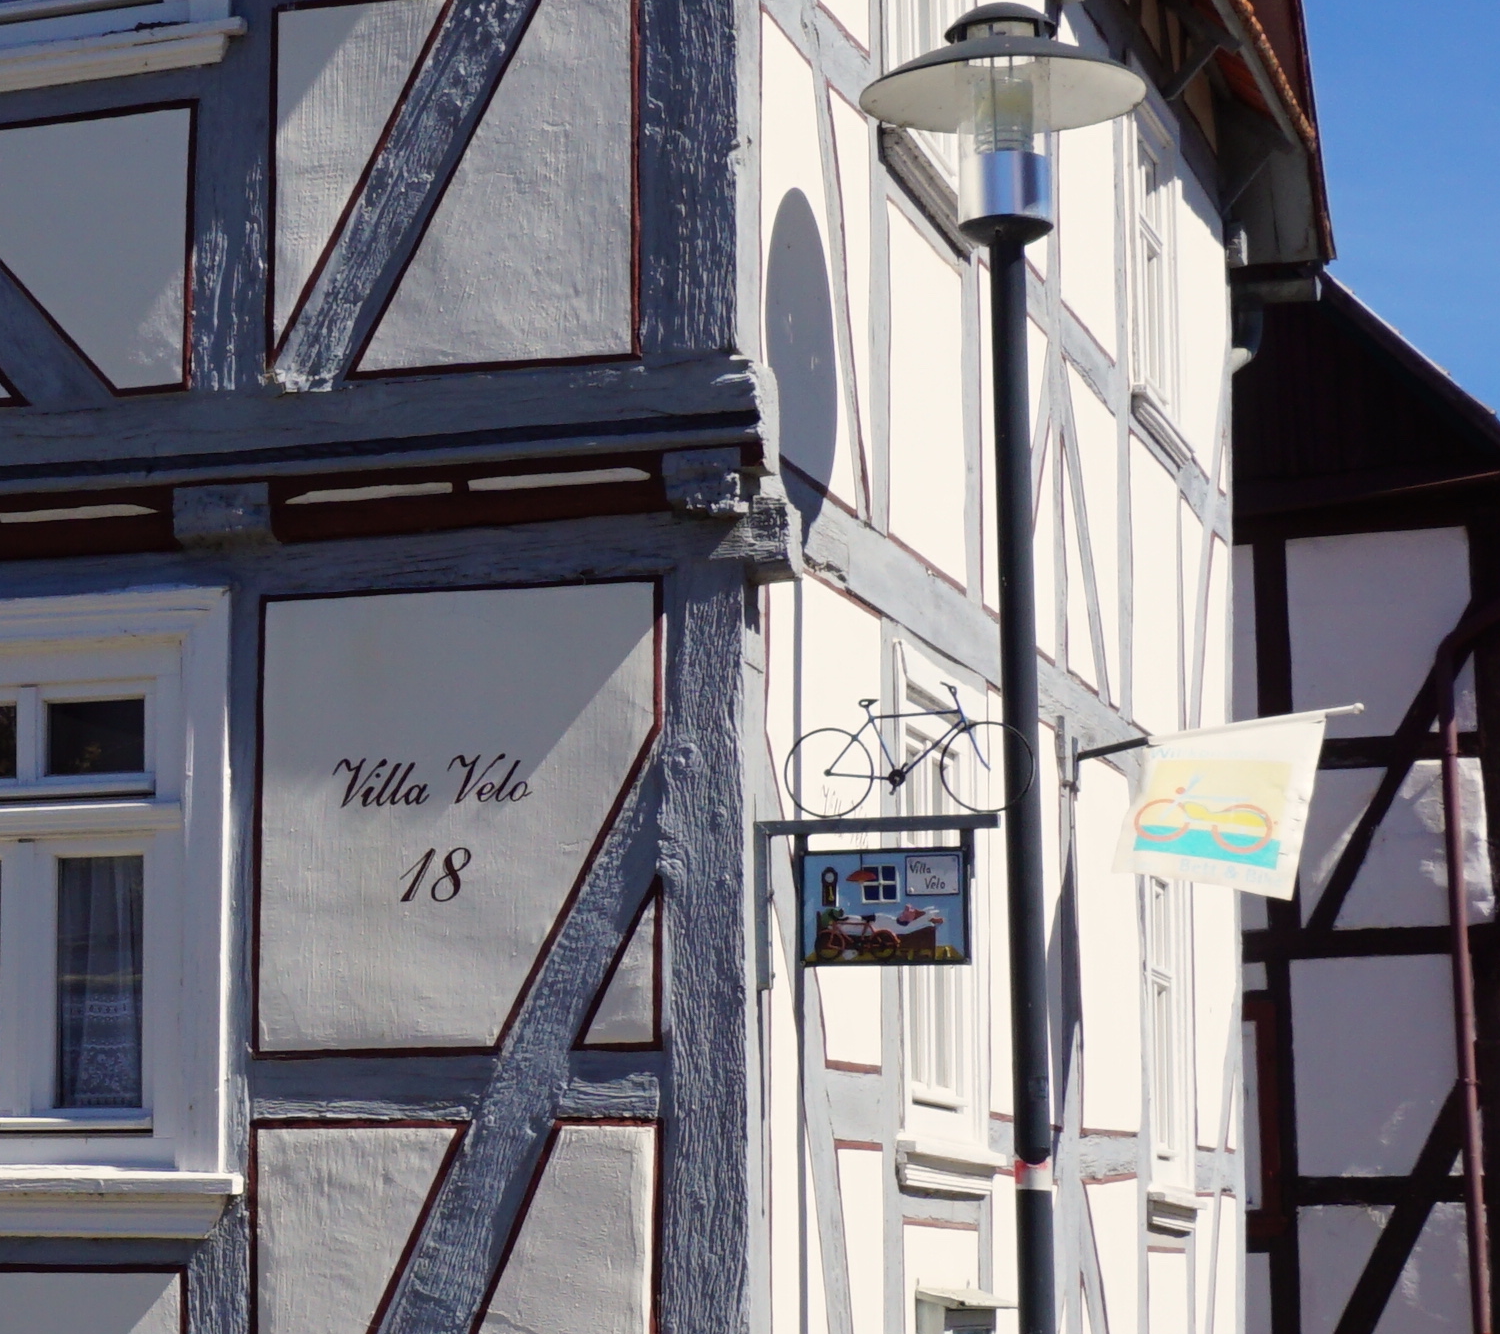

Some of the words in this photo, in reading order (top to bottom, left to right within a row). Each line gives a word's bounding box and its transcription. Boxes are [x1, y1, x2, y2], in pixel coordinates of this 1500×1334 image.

[332, 757, 431, 808] Villa
[447, 753, 533, 805] Velo
[400, 847, 472, 902] 18
[909, 861, 931, 874] Villa
[924, 875, 946, 890] Velo
